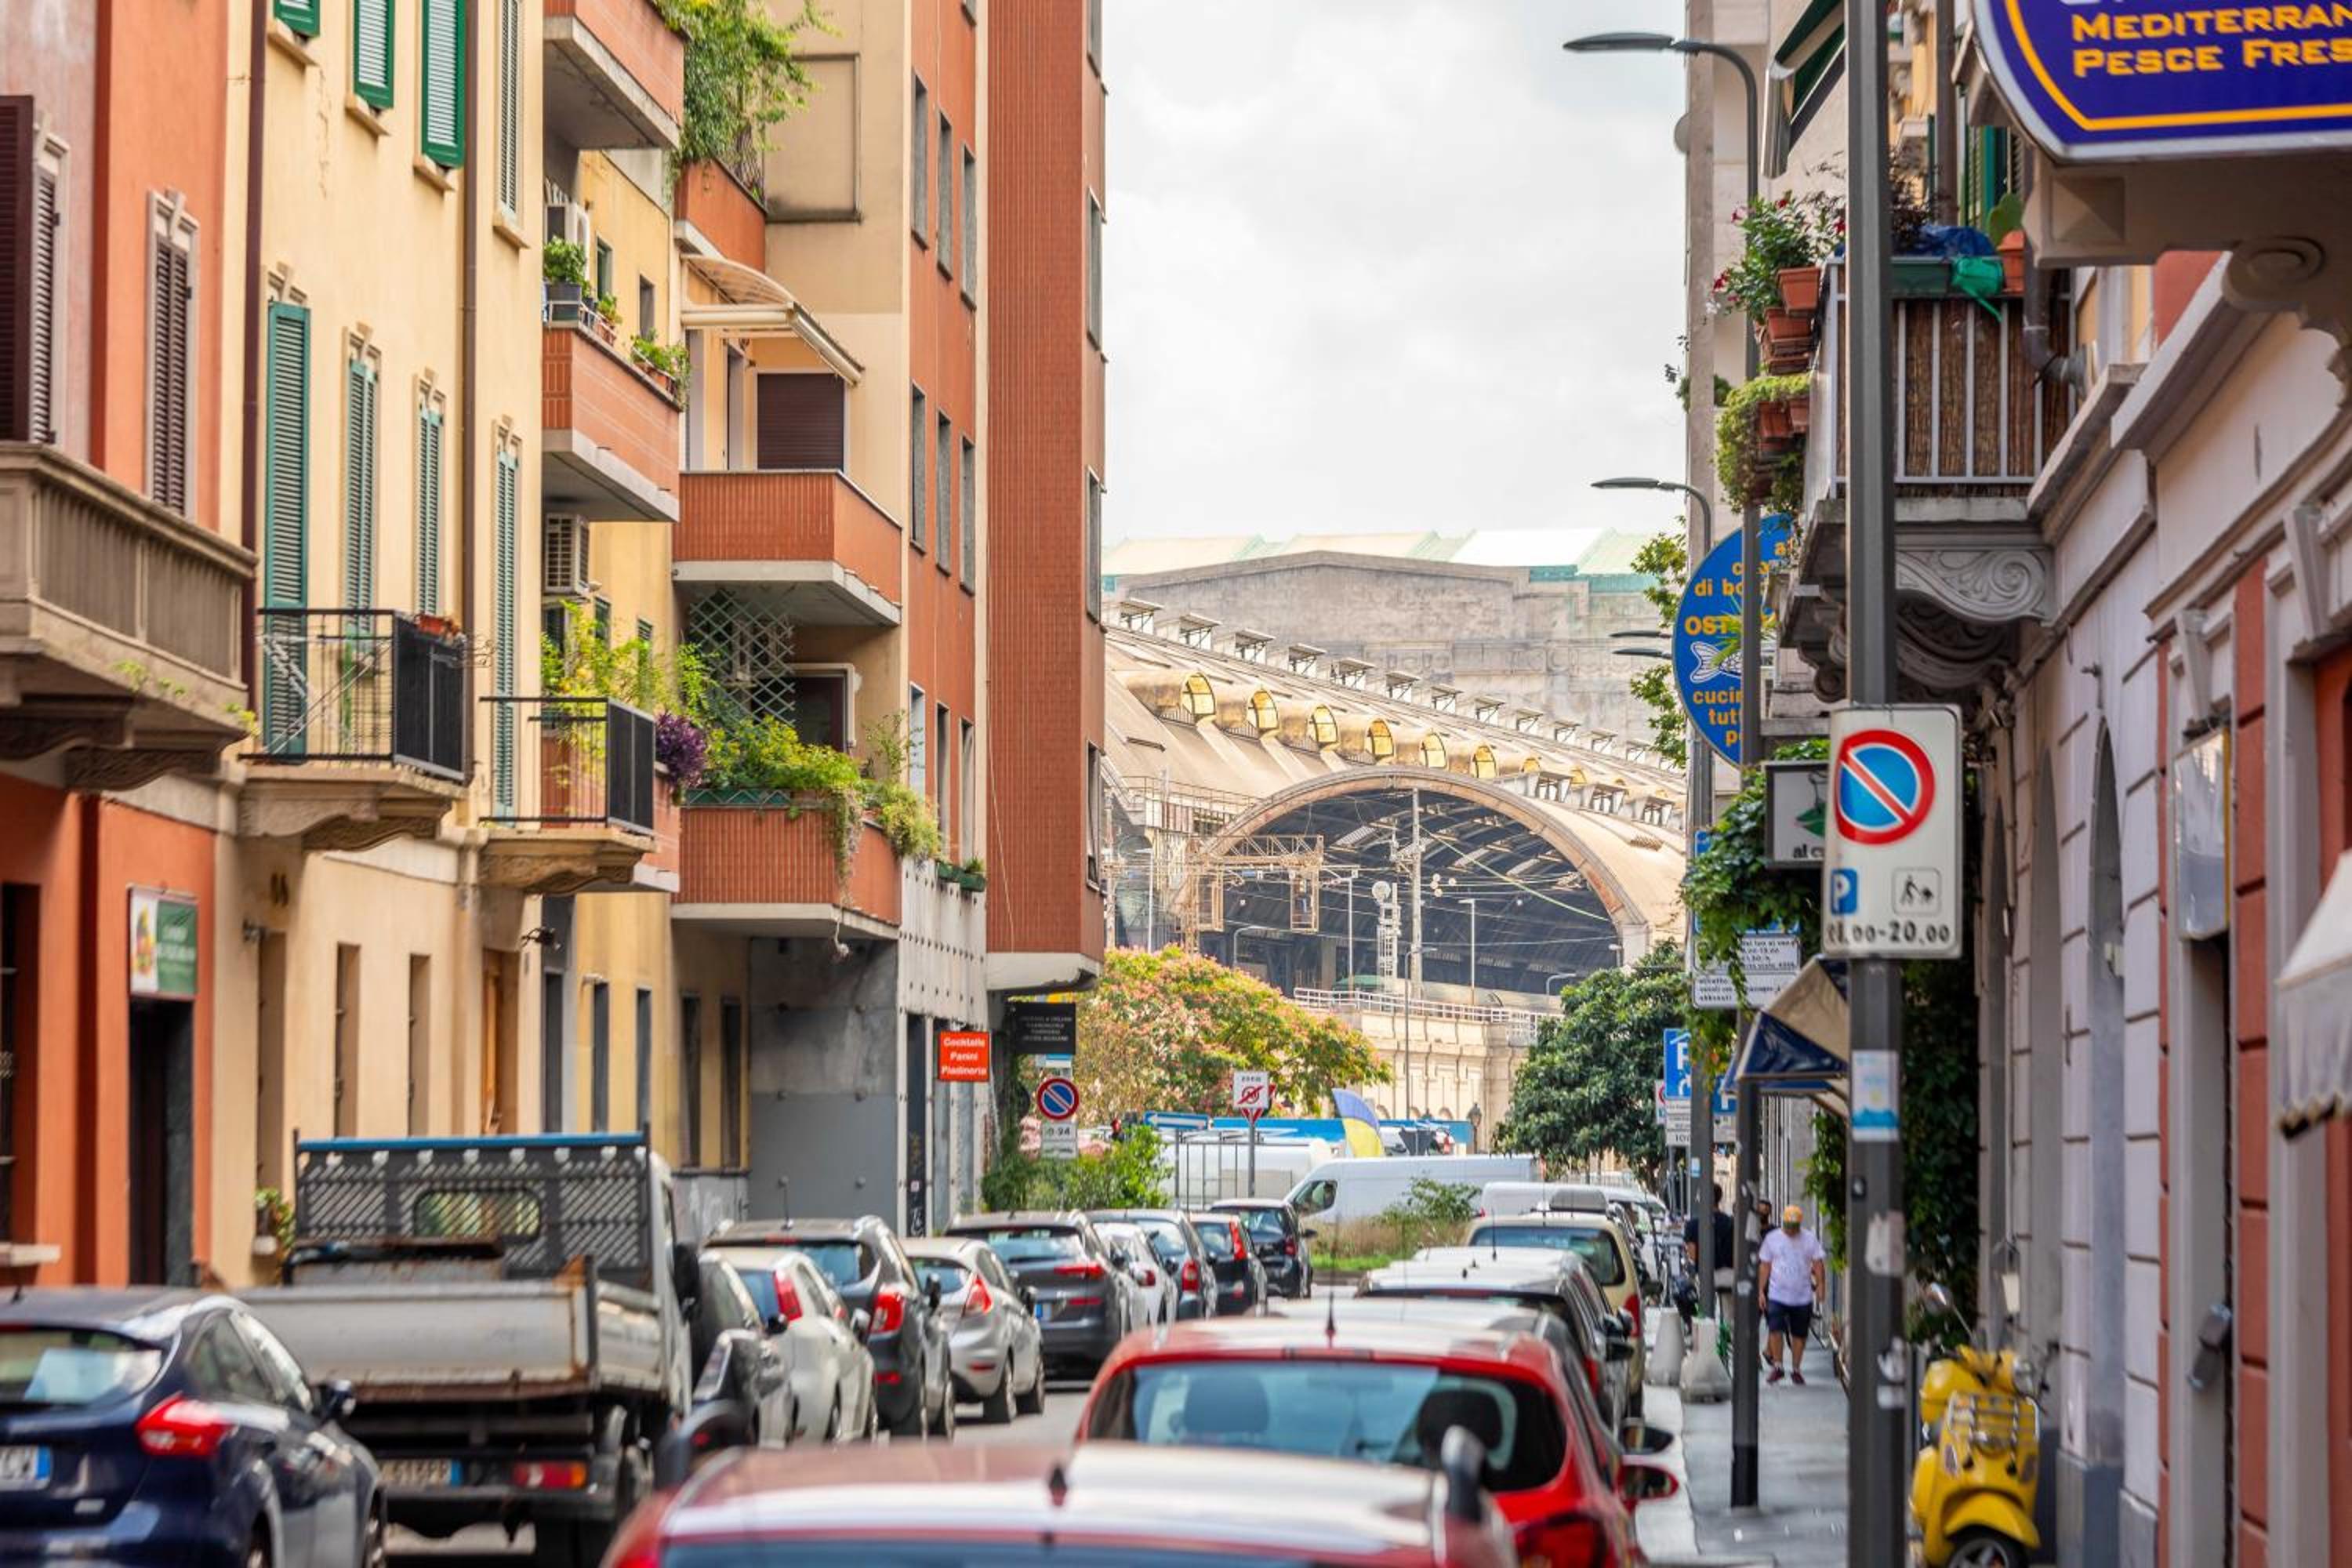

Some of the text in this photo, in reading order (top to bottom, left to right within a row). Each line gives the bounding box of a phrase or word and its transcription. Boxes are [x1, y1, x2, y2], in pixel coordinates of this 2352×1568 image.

[2074, 45, 2224, 78] PESCE
[1694, 579, 1712, 597] di
[1708, 709, 1742, 725] tut
[949, 1051, 978, 1061] Panini
